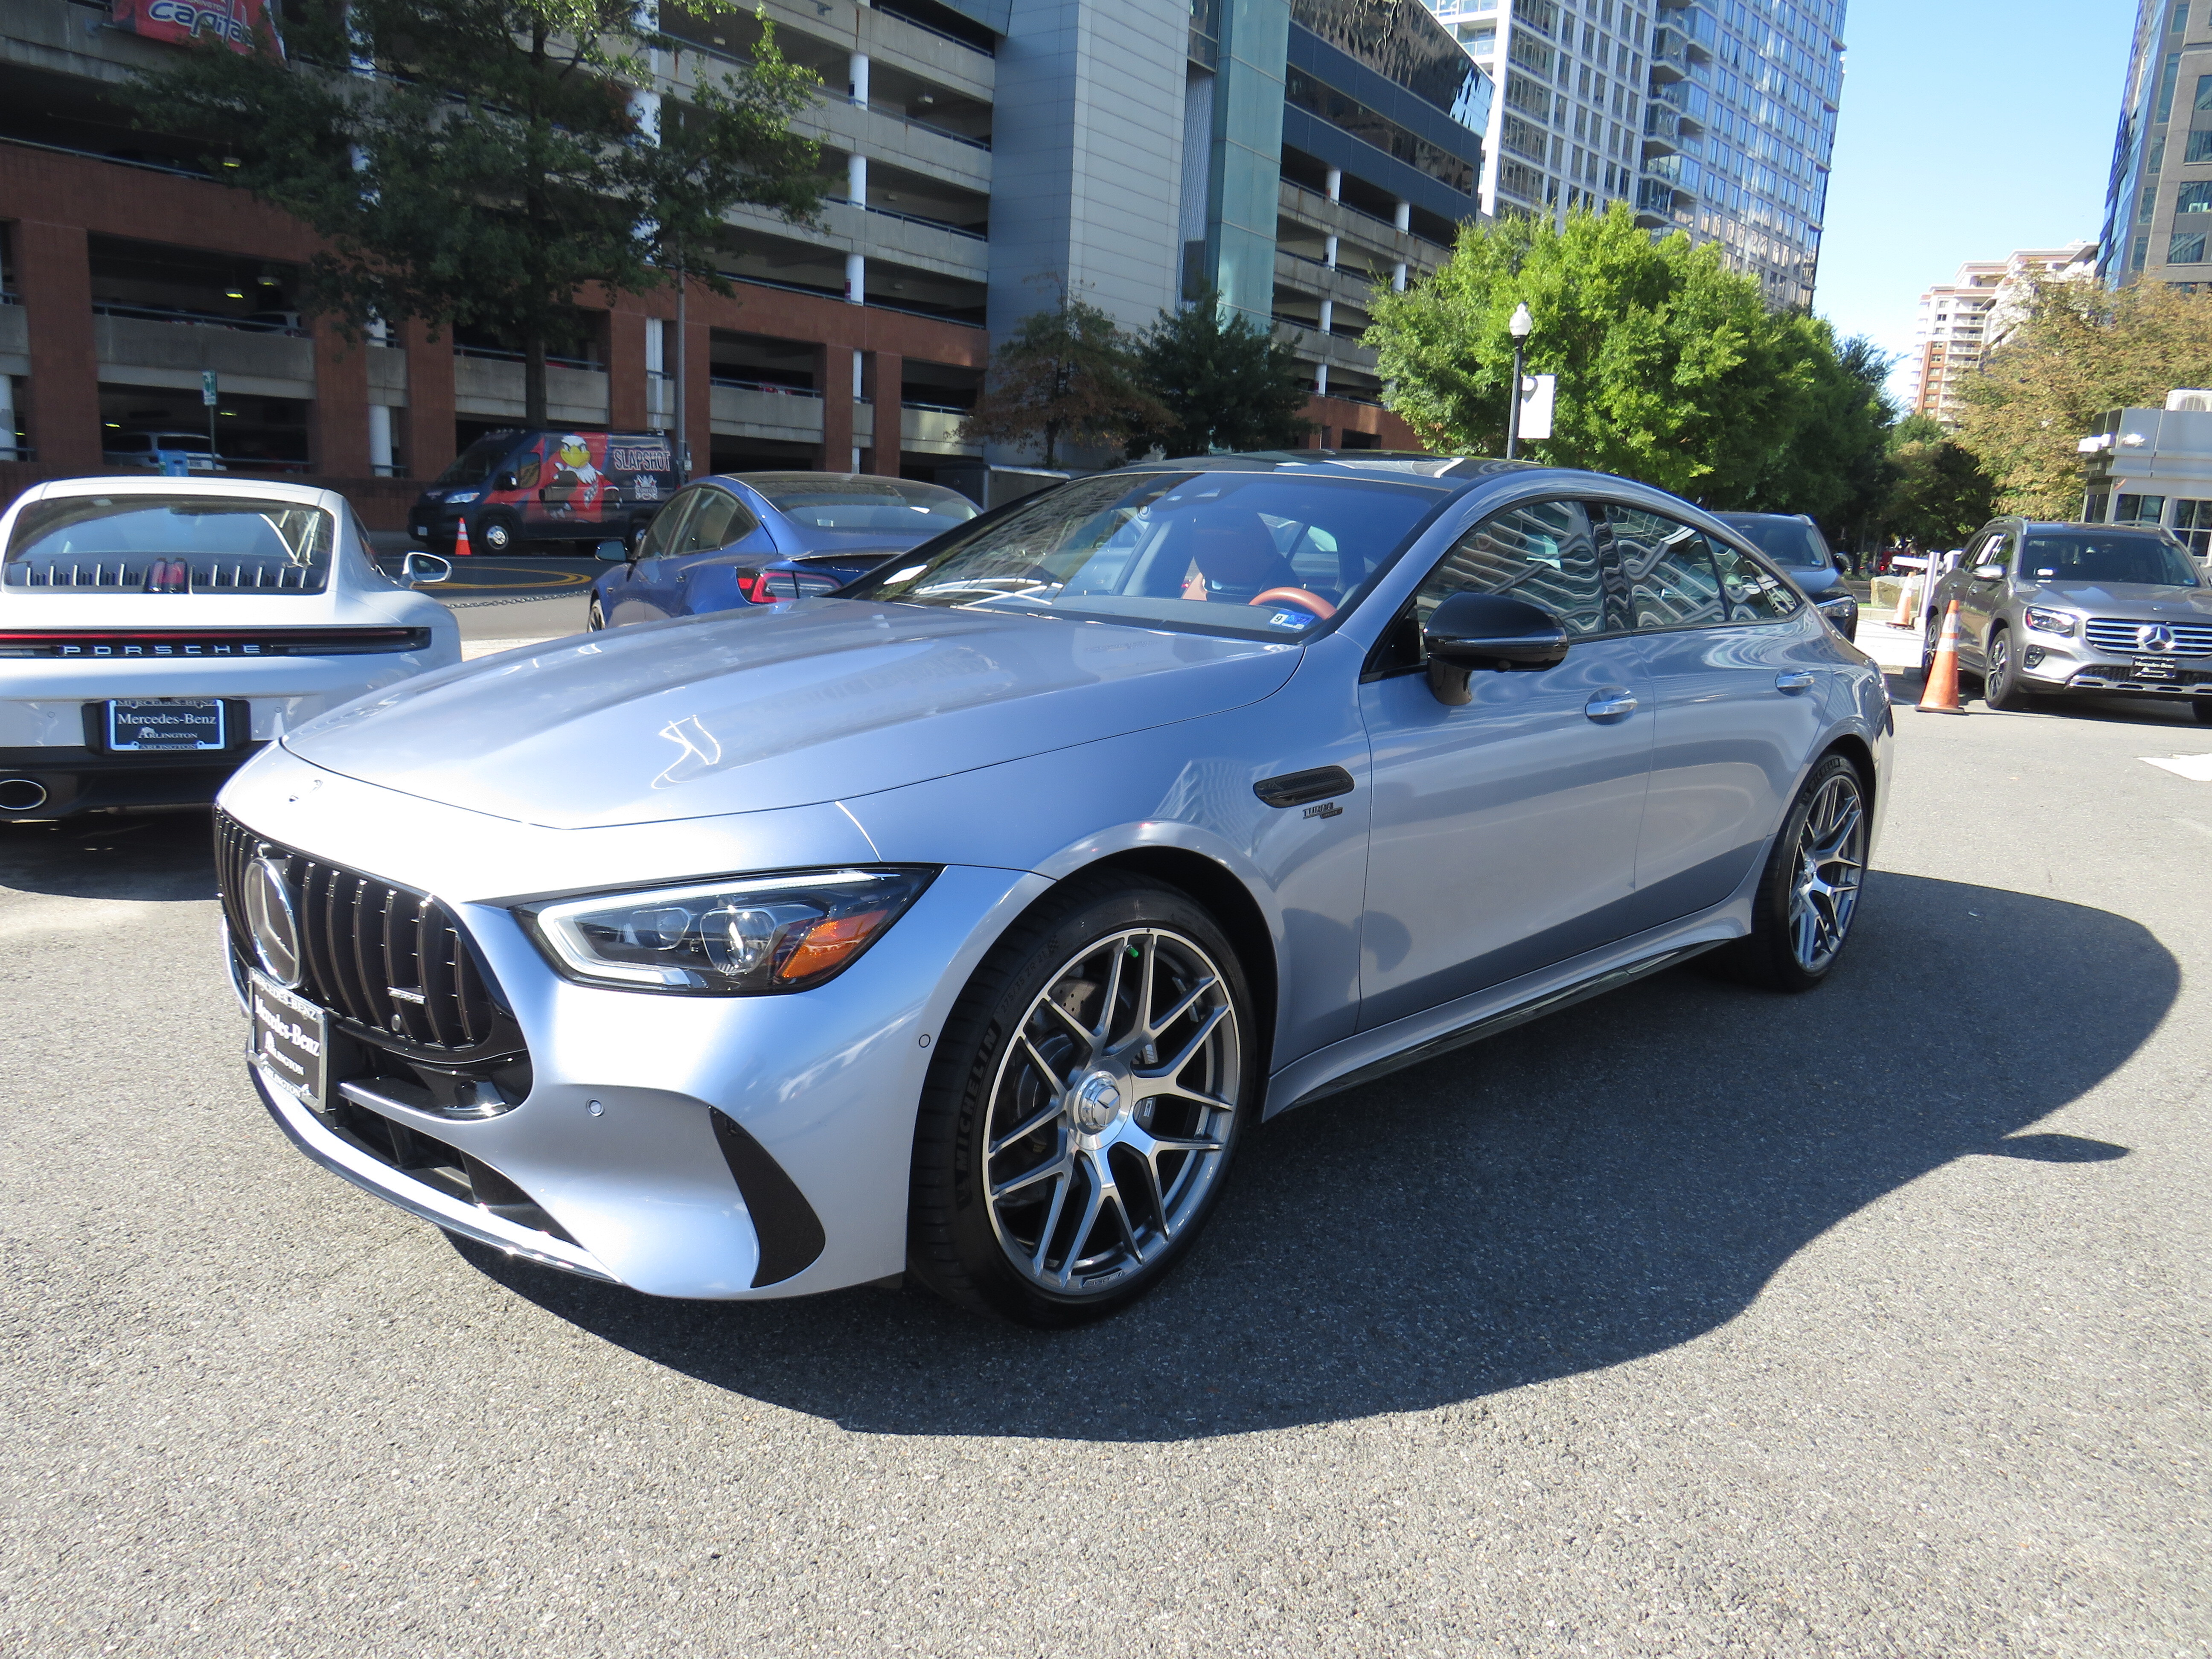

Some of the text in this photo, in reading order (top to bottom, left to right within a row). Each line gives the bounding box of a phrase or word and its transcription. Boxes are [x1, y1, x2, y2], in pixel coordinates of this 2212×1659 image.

[614, 449, 671, 471] SLAPSHOT
[64, 645, 261, 655] PORSCHE
[117, 713, 216, 725] Mercedes-Benz
[1303, 802, 1334, 817] TURBO
[252, 970, 317, 1021] MERCEDES-BENZ
[255, 994, 320, 1057] Mercedes-Benz
[263, 1065, 301, 1097] ARLINGTON
[956, 1027, 997, 1171] MICHELIN
